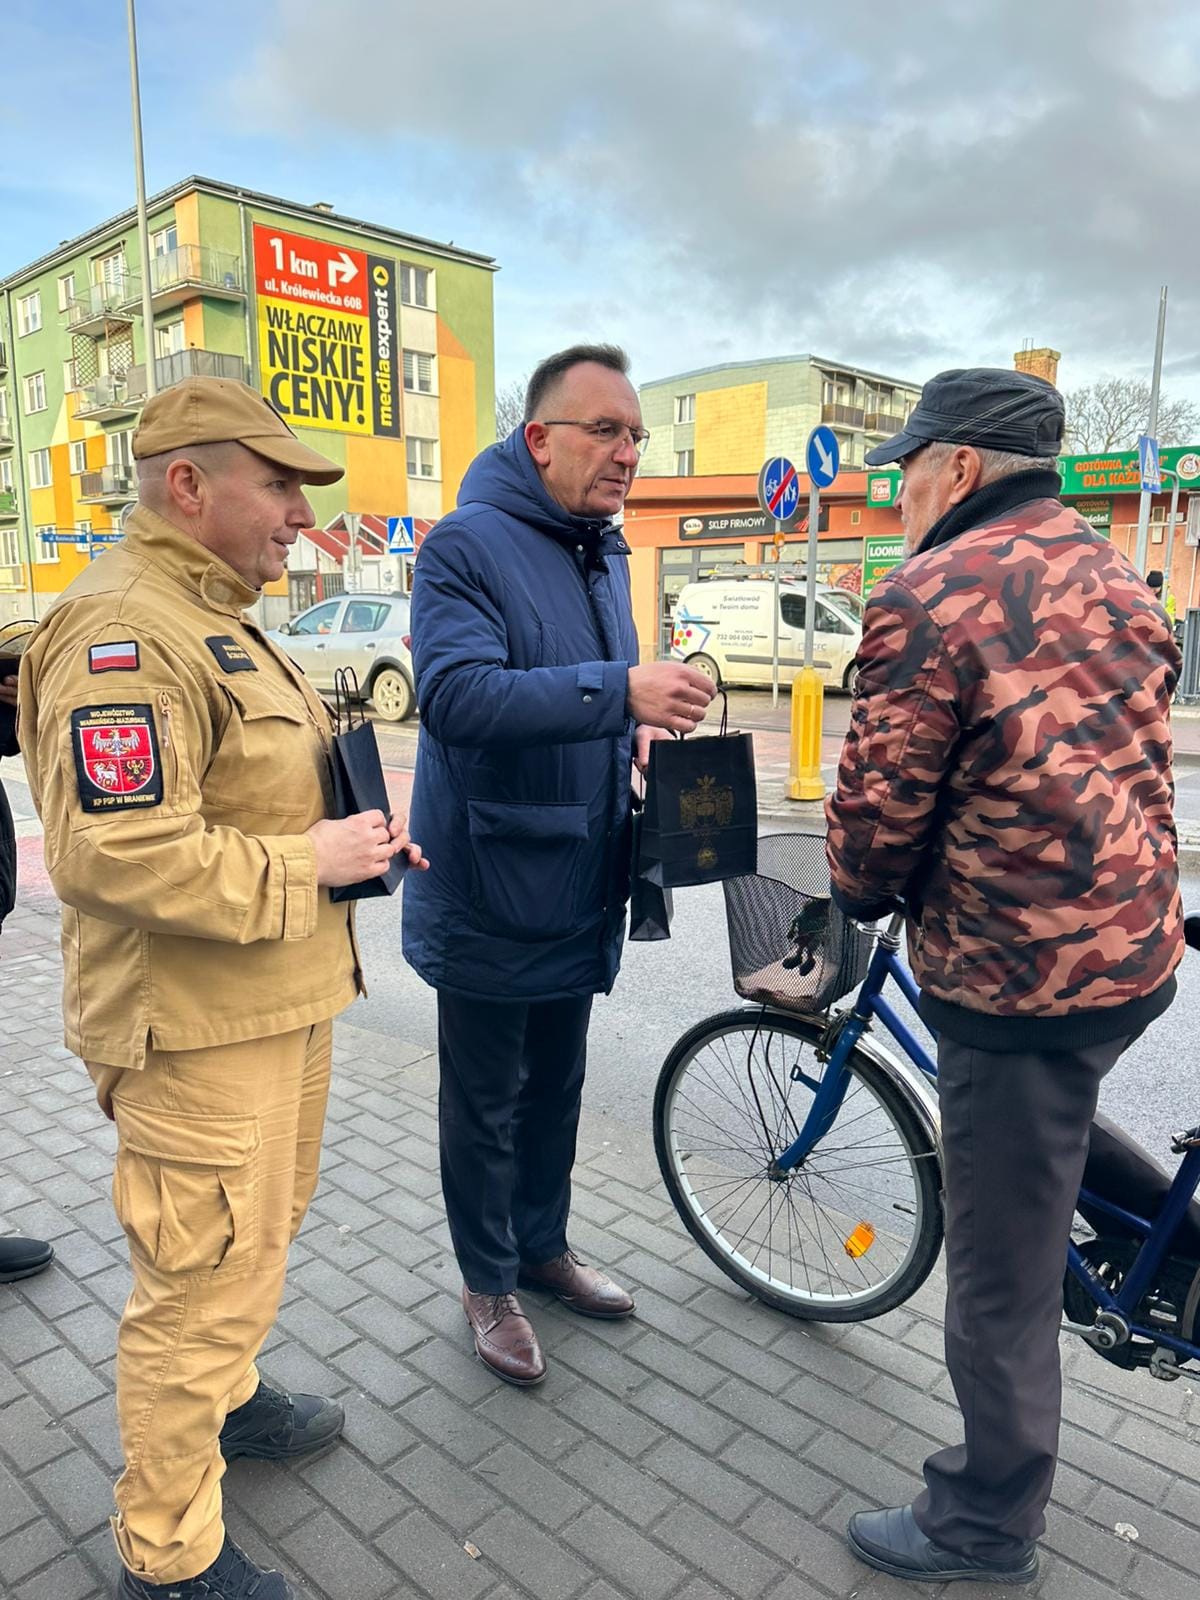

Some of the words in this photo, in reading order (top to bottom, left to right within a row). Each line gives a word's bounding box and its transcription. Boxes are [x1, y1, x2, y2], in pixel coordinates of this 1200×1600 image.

[269, 237, 284, 271] 1
[290, 250, 318, 279] km
[264, 278, 280, 293] ul.
[281, 281, 342, 306] Królewiecka
[343, 294, 362, 310] 60B
[265, 305, 363, 345] WŁĄCZAMY
[267, 330, 365, 383] NISKIE
[374, 288, 393, 427] mediaexpert
[269, 371, 365, 425] CENY!
[1075, 459, 1122, 472] GOTÓWKA
[1083, 474, 1105, 487] DLA
[708, 519, 729, 530] SKLEP
[730, 516, 767, 529] FIRMOWY
[869, 545, 904, 557] LOOMB
